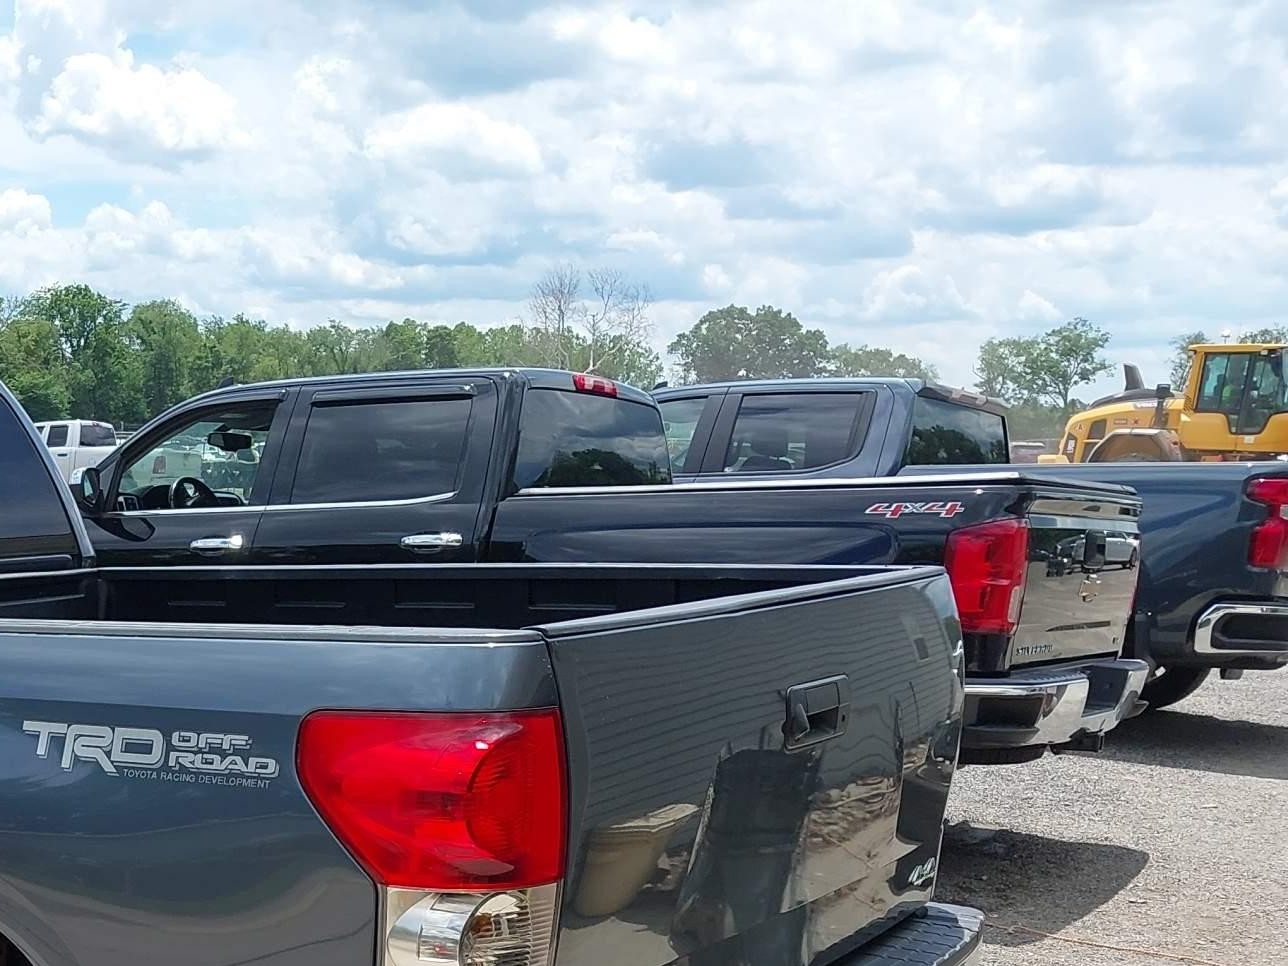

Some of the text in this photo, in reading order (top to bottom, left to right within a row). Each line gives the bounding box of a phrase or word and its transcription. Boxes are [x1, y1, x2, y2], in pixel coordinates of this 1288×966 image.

[22, 720, 166, 776] TRD
[171, 731, 254, 752] OFF
[168, 751, 280, 777] ROAD
[123, 768, 271, 790] TOYOTA RACING DEVELOPMENT
